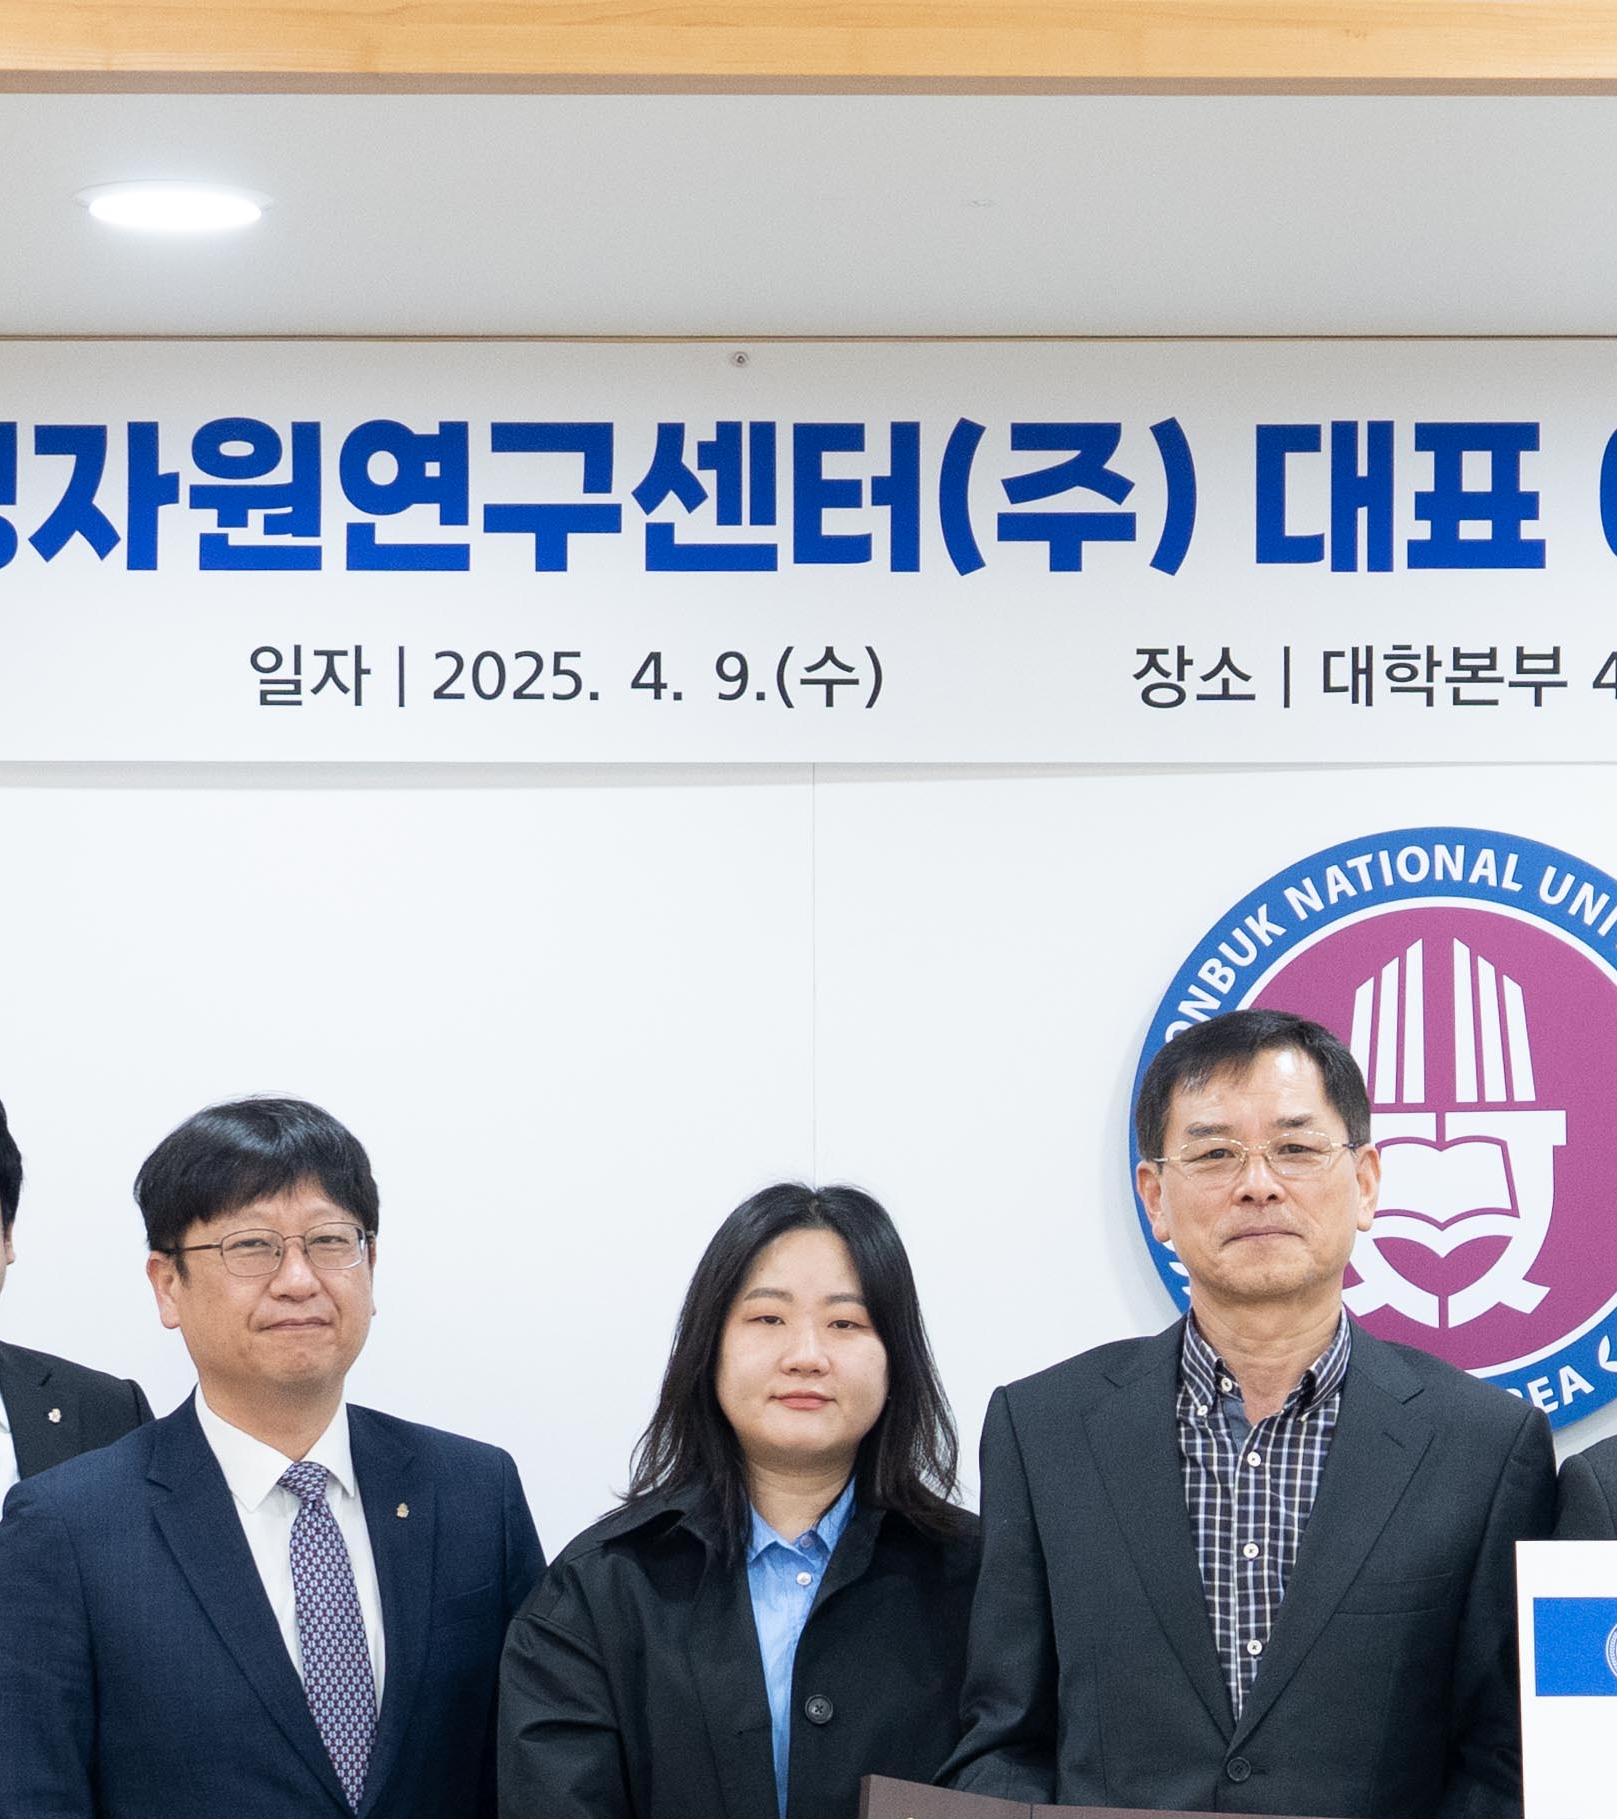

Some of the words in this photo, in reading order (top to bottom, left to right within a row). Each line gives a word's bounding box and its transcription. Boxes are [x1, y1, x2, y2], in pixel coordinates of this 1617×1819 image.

[1254, 419, 1547, 574] 대표
[250, 644, 373, 707] 일자
[432, 649, 600, 702] 2025.
[629, 650, 684, 702] 4.
[714, 645, 884, 709] 9.(수)
[1131, 644, 1257, 709] 장소
[1321, 644, 1569, 709] 대학본부
[1283, 842, 1524, 923] NATIONAL
